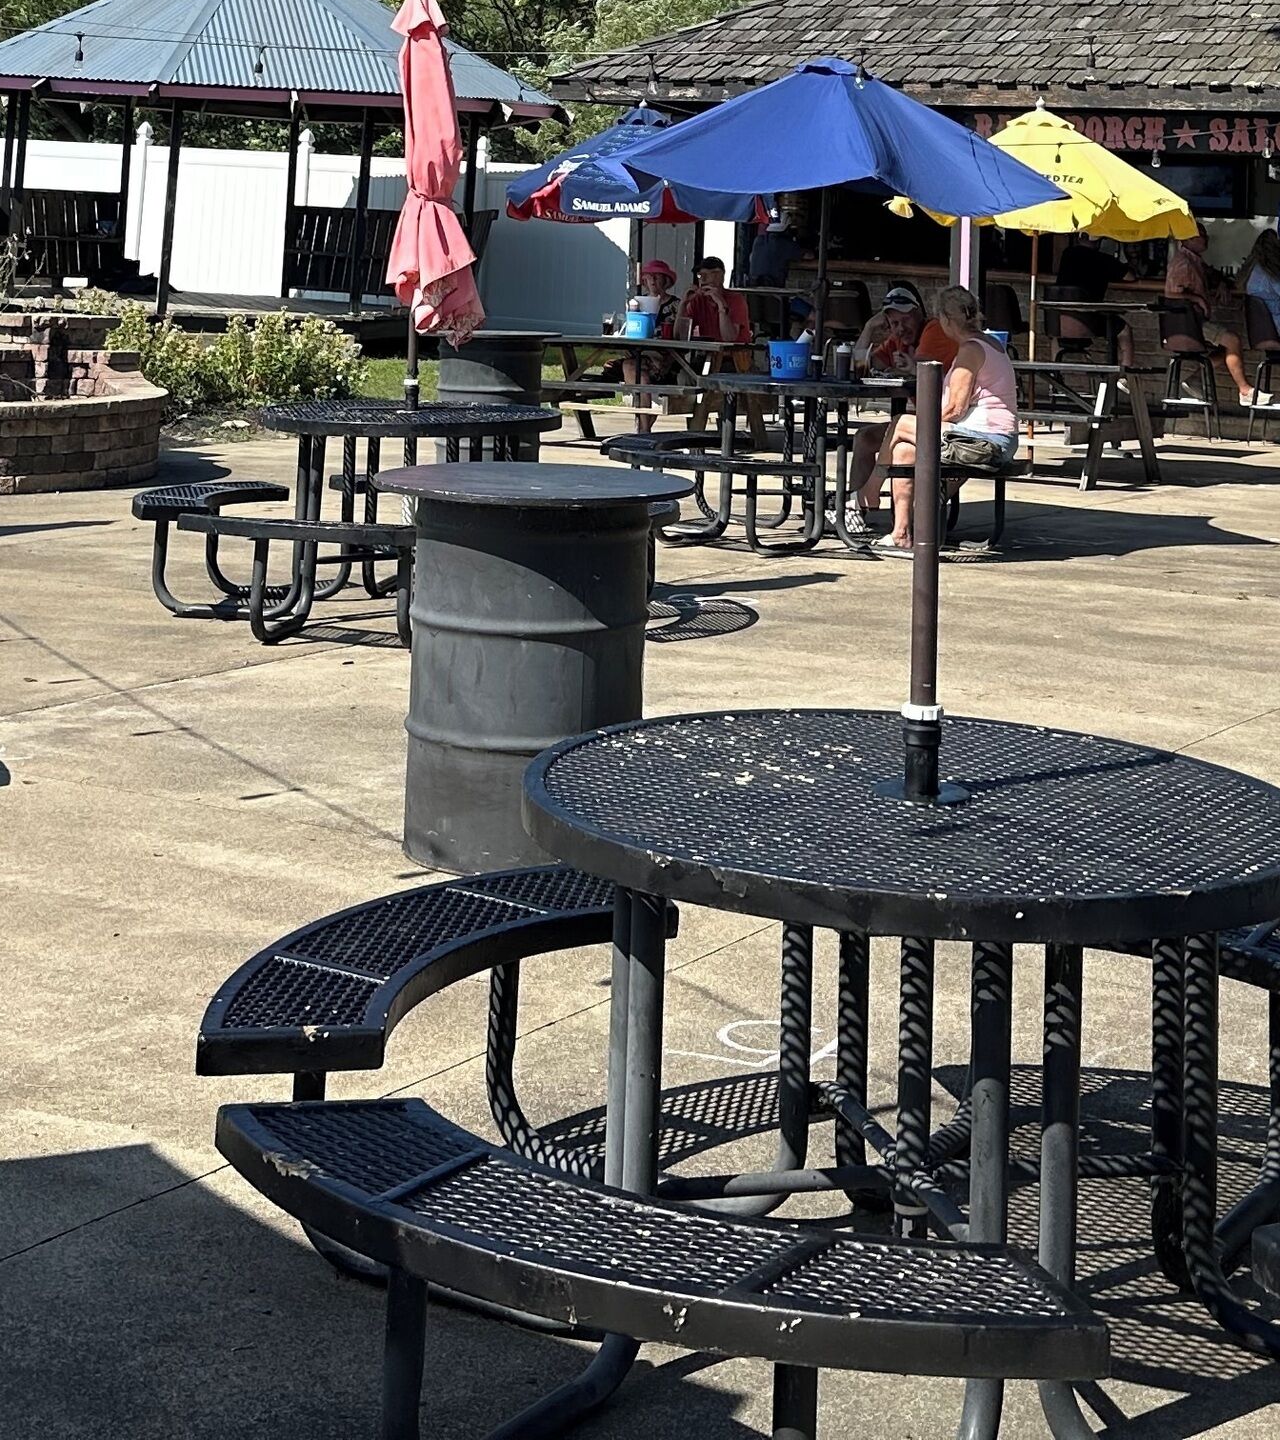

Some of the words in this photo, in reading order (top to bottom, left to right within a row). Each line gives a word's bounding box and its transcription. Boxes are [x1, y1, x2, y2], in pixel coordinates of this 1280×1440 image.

[1062, 174, 1084, 185] TEA
[572, 197, 613, 212] SAMUEL
[614, 201, 650, 213] ADAMS
